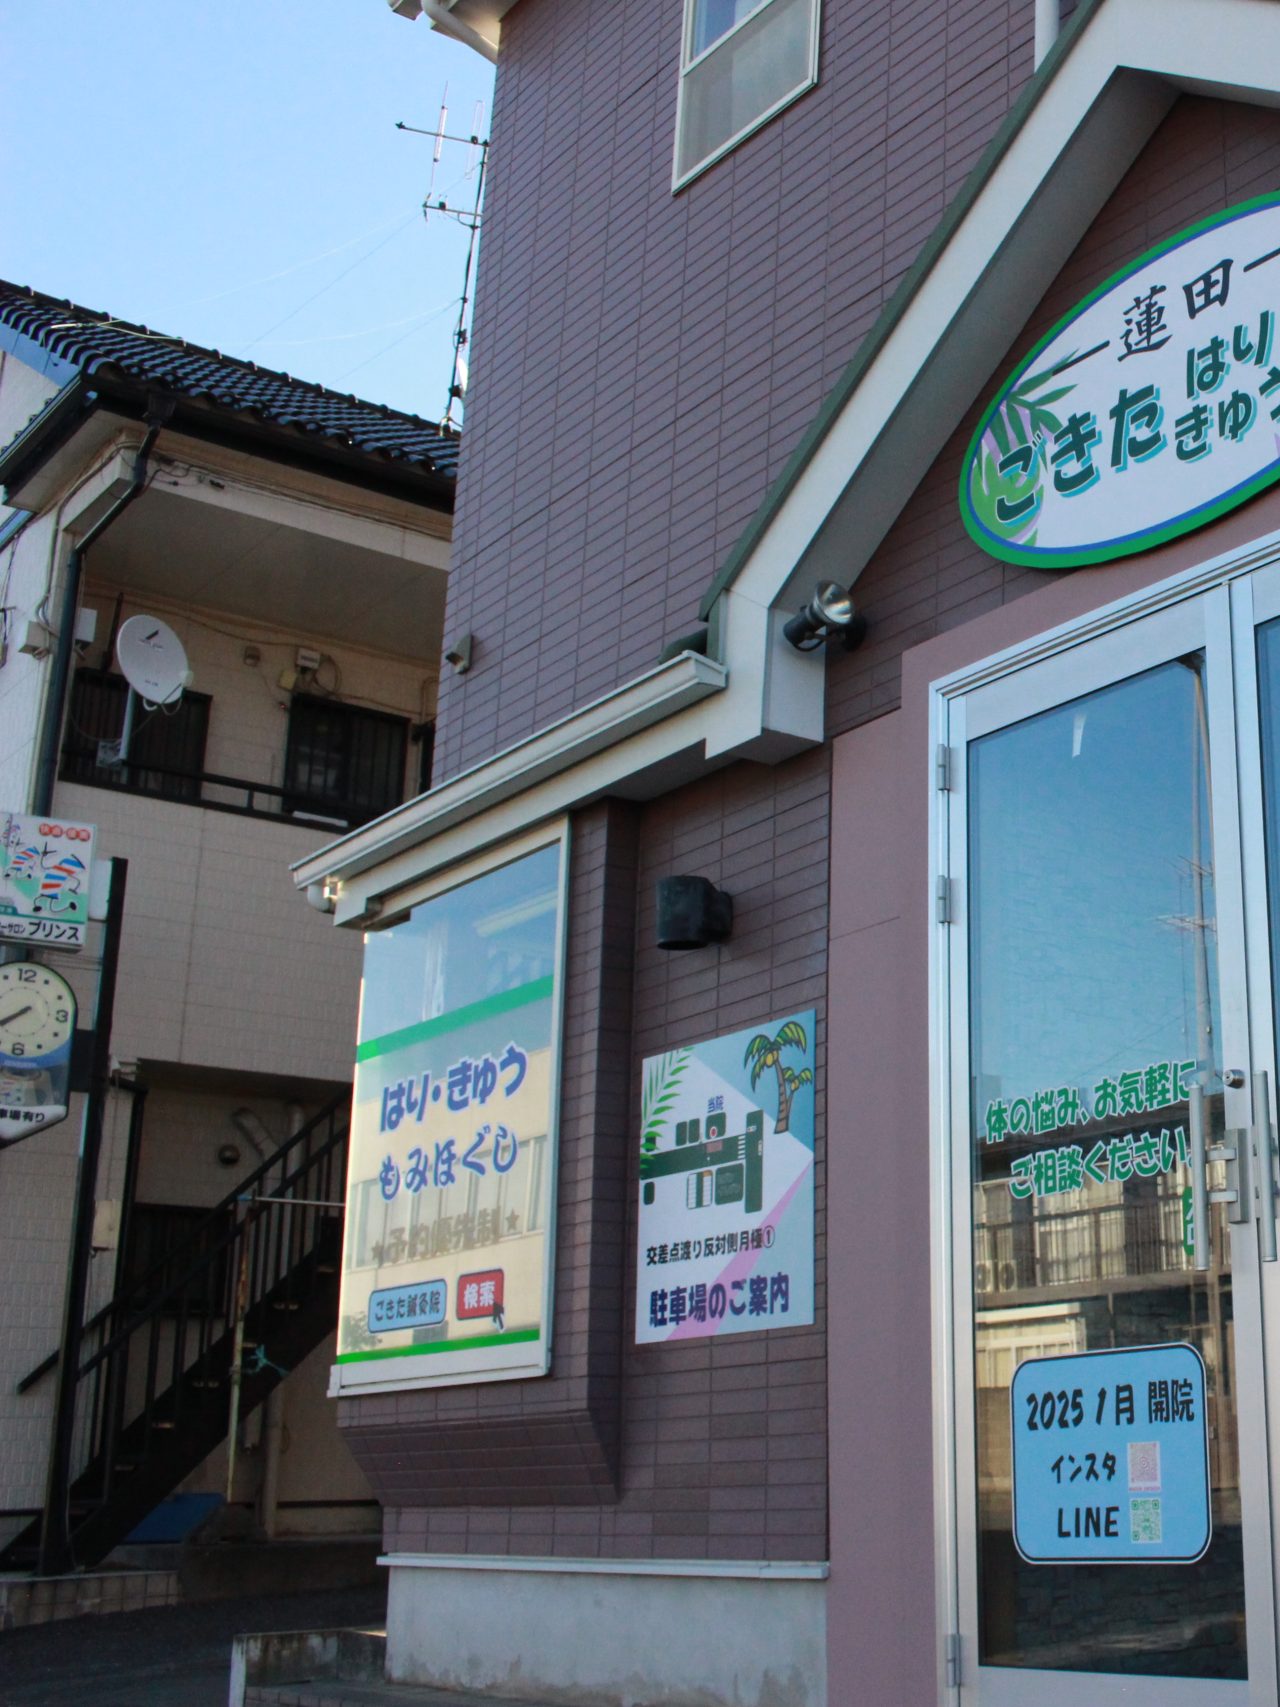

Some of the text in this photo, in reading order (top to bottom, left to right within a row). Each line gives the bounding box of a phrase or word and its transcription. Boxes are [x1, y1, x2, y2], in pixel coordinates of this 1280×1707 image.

[1117, 258, 1234, 362] 蓮田
[1186, 310, 1275, 399] はり
[996, 384, 1166, 522] ごきた
[18, 968, 37, 983] 12
[12, 1042, 24, 1056] 6
[380, 1042, 528, 1132] はり・きゅう
[985, 1059, 1196, 1144] 体の悩み、お気軽に
[378, 1123, 519, 1201] もみほぐし
[463, 1280, 496, 1310] 検索
[649, 1271, 790, 1328] 駐車場のご案内
[1026, 1388, 1084, 1431] 2025
[1148, 1378, 1195, 1424] 開院
[1051, 1452, 1117, 1484] インスタ
[1057, 1506, 1121, 1538] LINE
